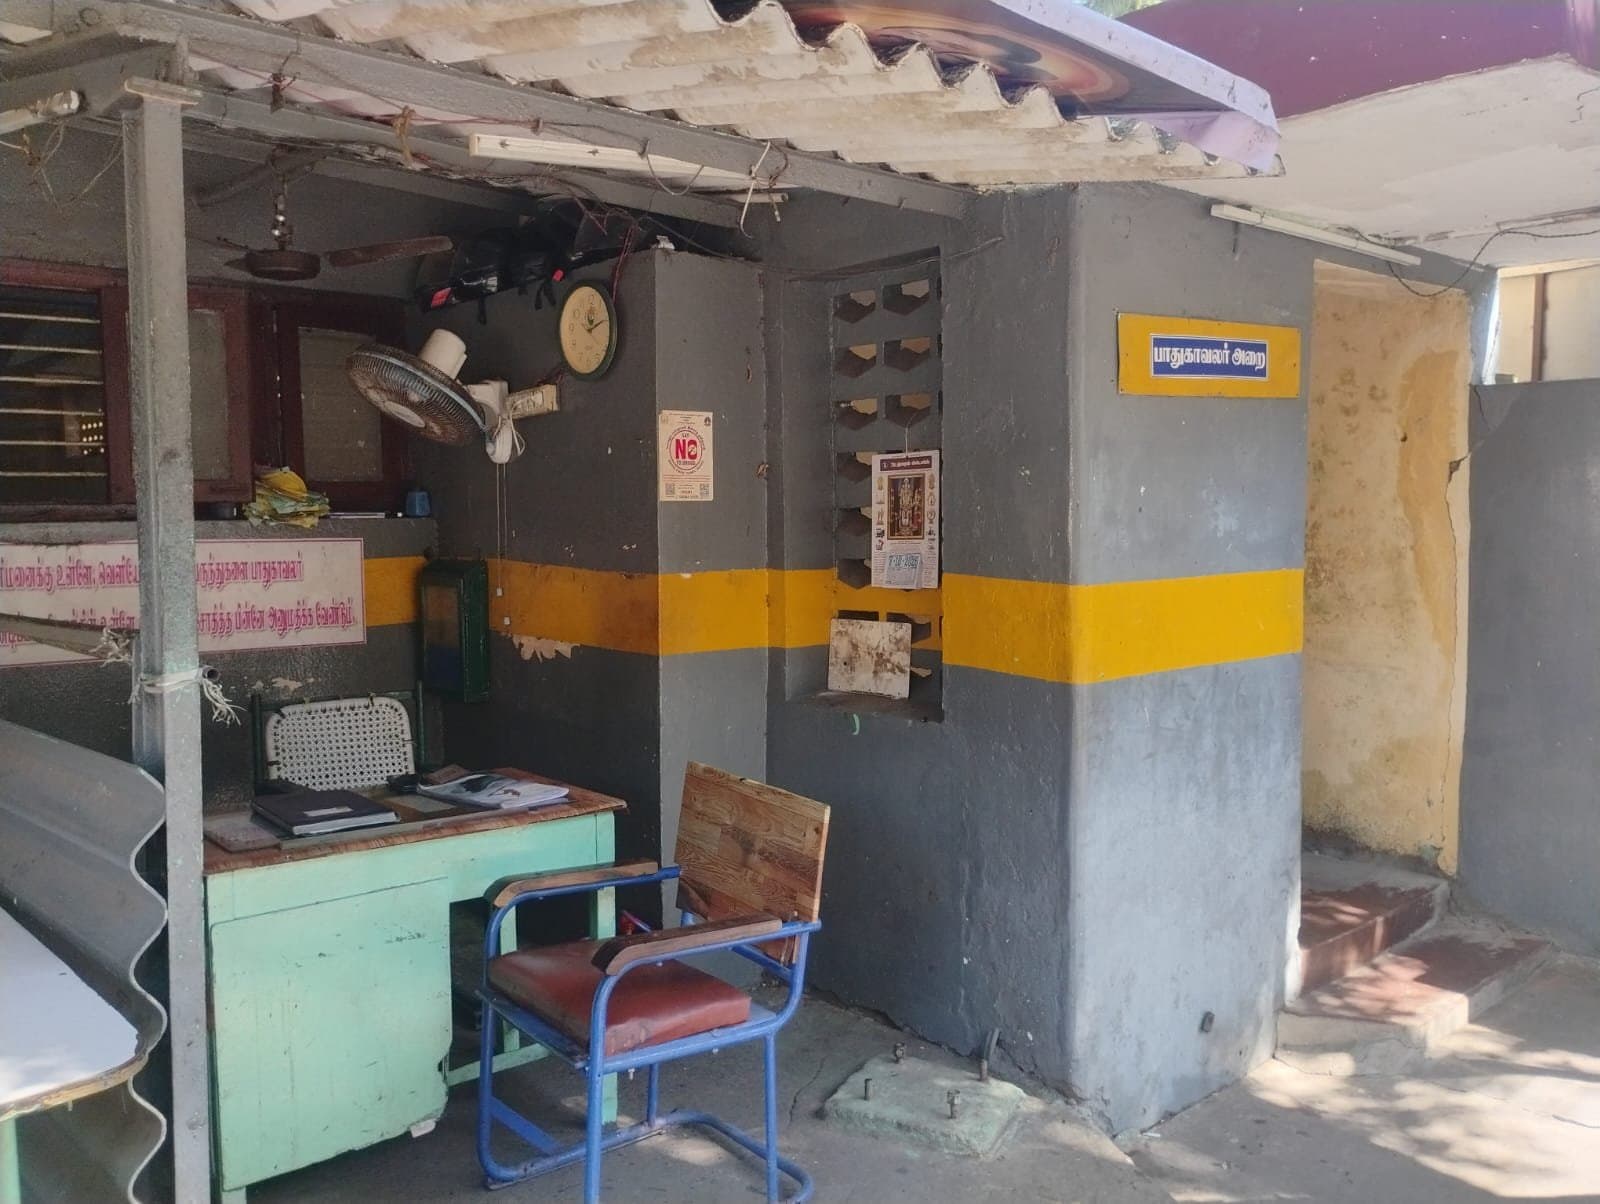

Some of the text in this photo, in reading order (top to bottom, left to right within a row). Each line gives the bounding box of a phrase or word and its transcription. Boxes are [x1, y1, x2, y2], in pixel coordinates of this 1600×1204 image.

[1154, 342, 1266, 371] பாதுகாவலர் அறை
[675, 438, 698, 460] NO
[252, 550, 304, 588] பாதுகாவலர்
[268, 599, 314, 636] அனுமதிக்க
